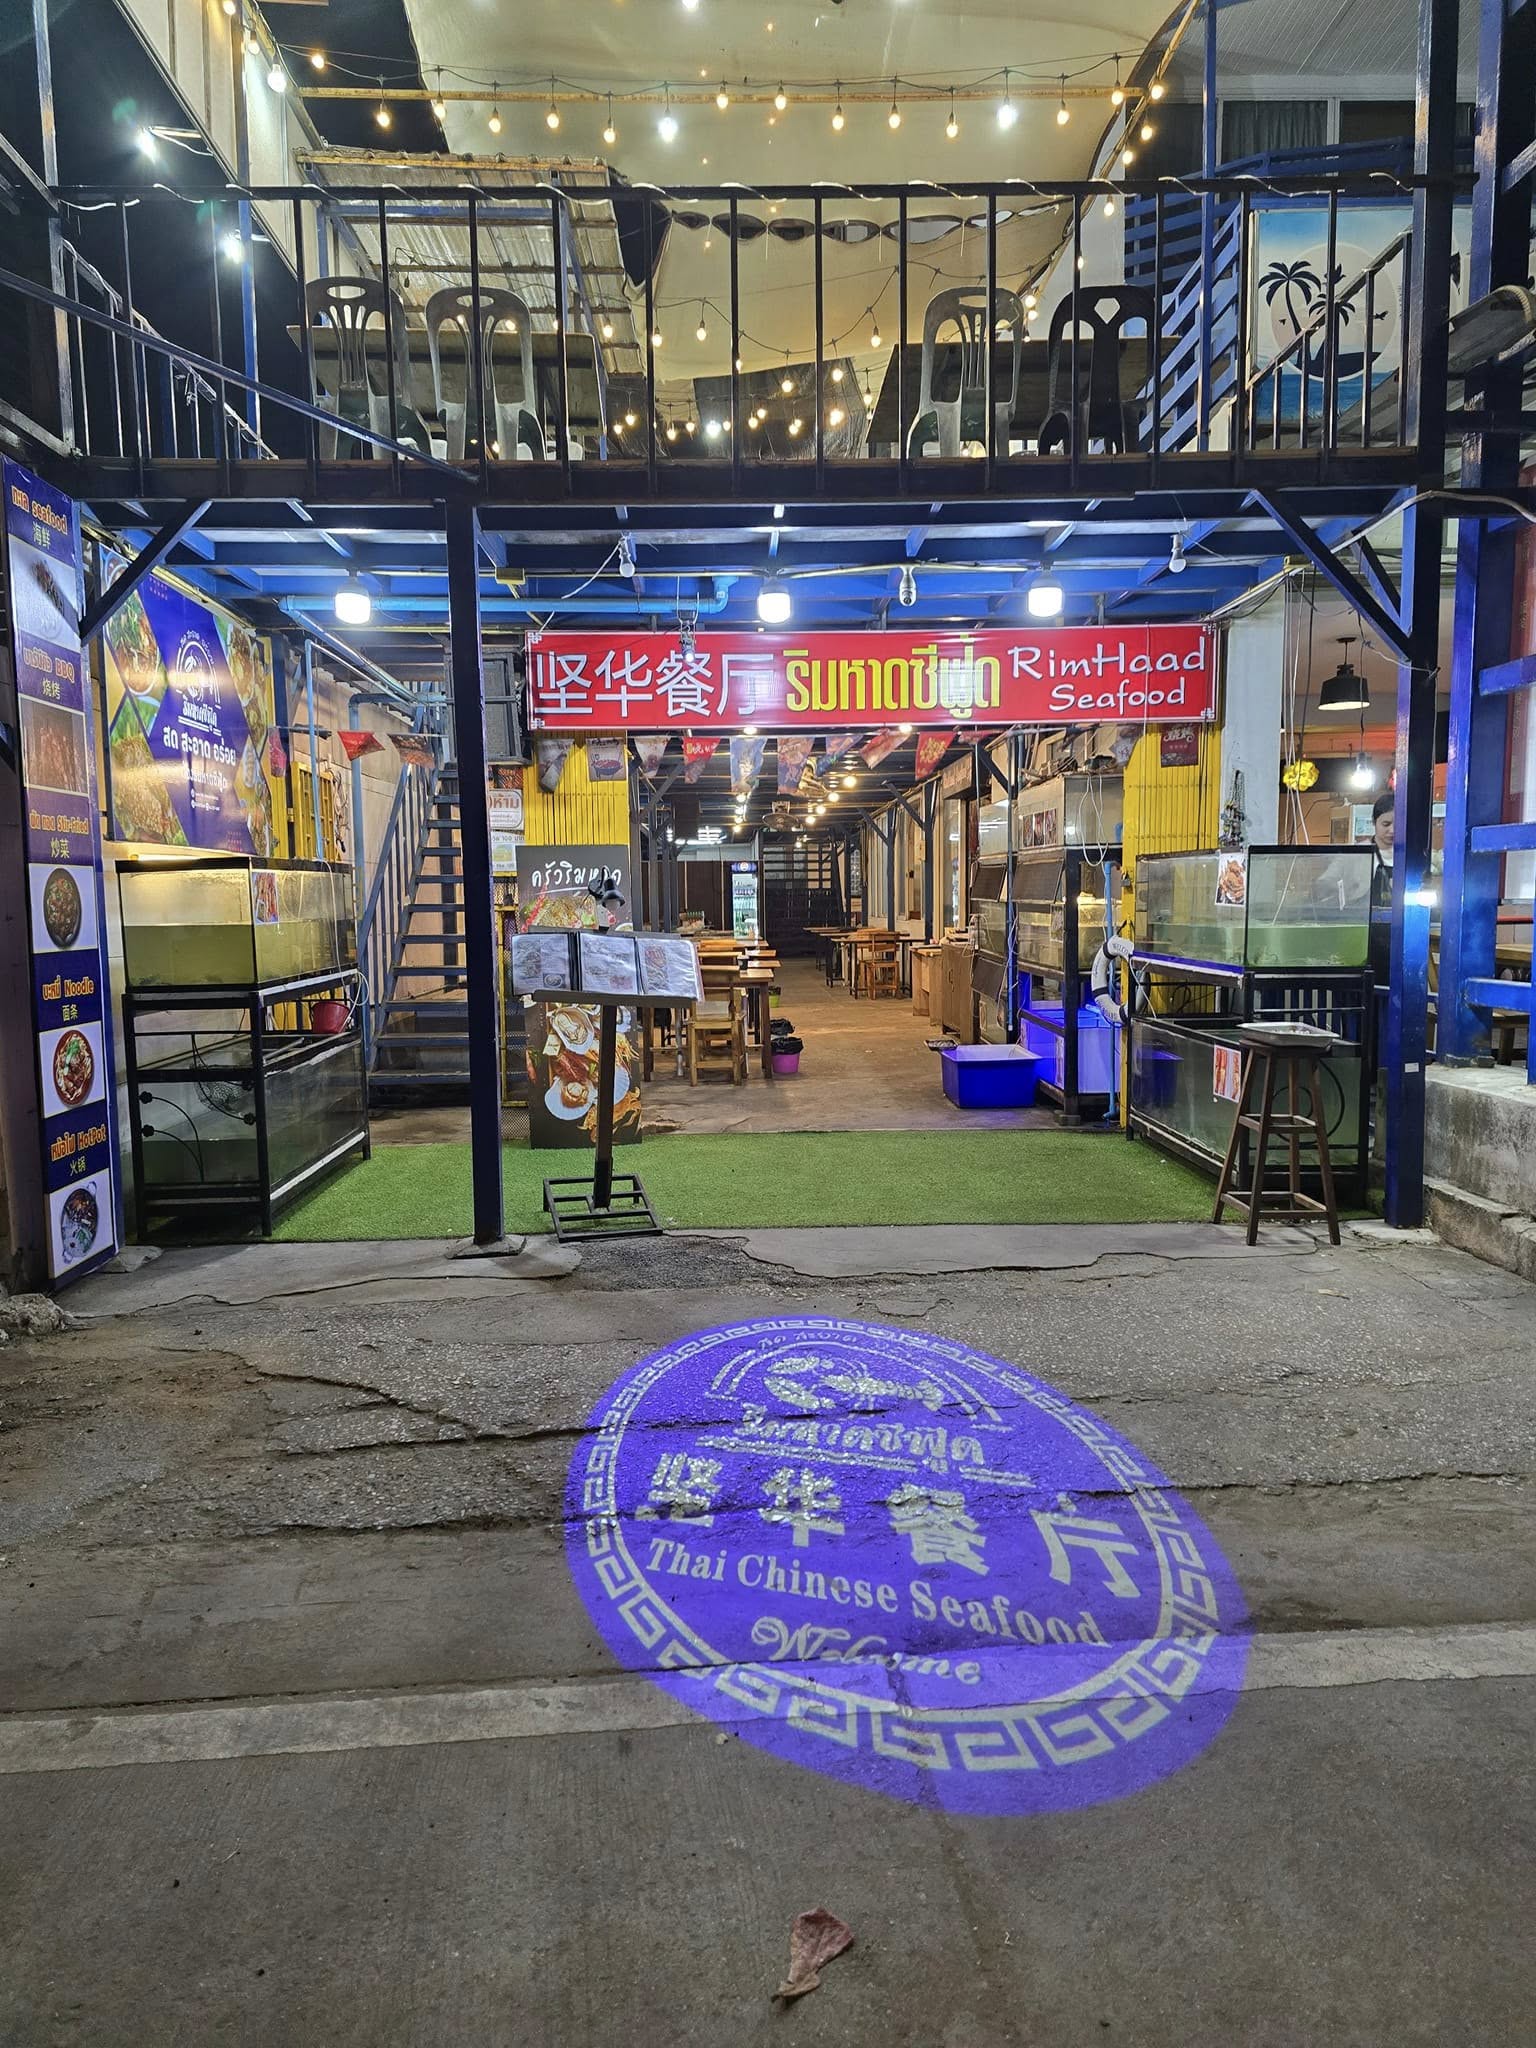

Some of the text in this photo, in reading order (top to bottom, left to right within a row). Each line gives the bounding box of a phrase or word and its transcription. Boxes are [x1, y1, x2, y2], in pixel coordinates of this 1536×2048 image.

[31, 500, 68, 536] seafood
[32, 520, 51, 549] 海鲜
[55, 657, 75, 684] BBQ
[1007, 636, 1206, 680] RimHaad
[534, 650, 775, 718] 坚华餐厅
[1049, 676, 1186, 715] Seafood
[163, 725, 237, 767] สด สะอาด อร่อย
[50, 836, 70, 859] 炒菜
[63, 976, 94, 998] Noodle
[646, 1537, 1110, 1649] Thai Chinese Seafood
[751, 1616, 983, 1686] Welcome
